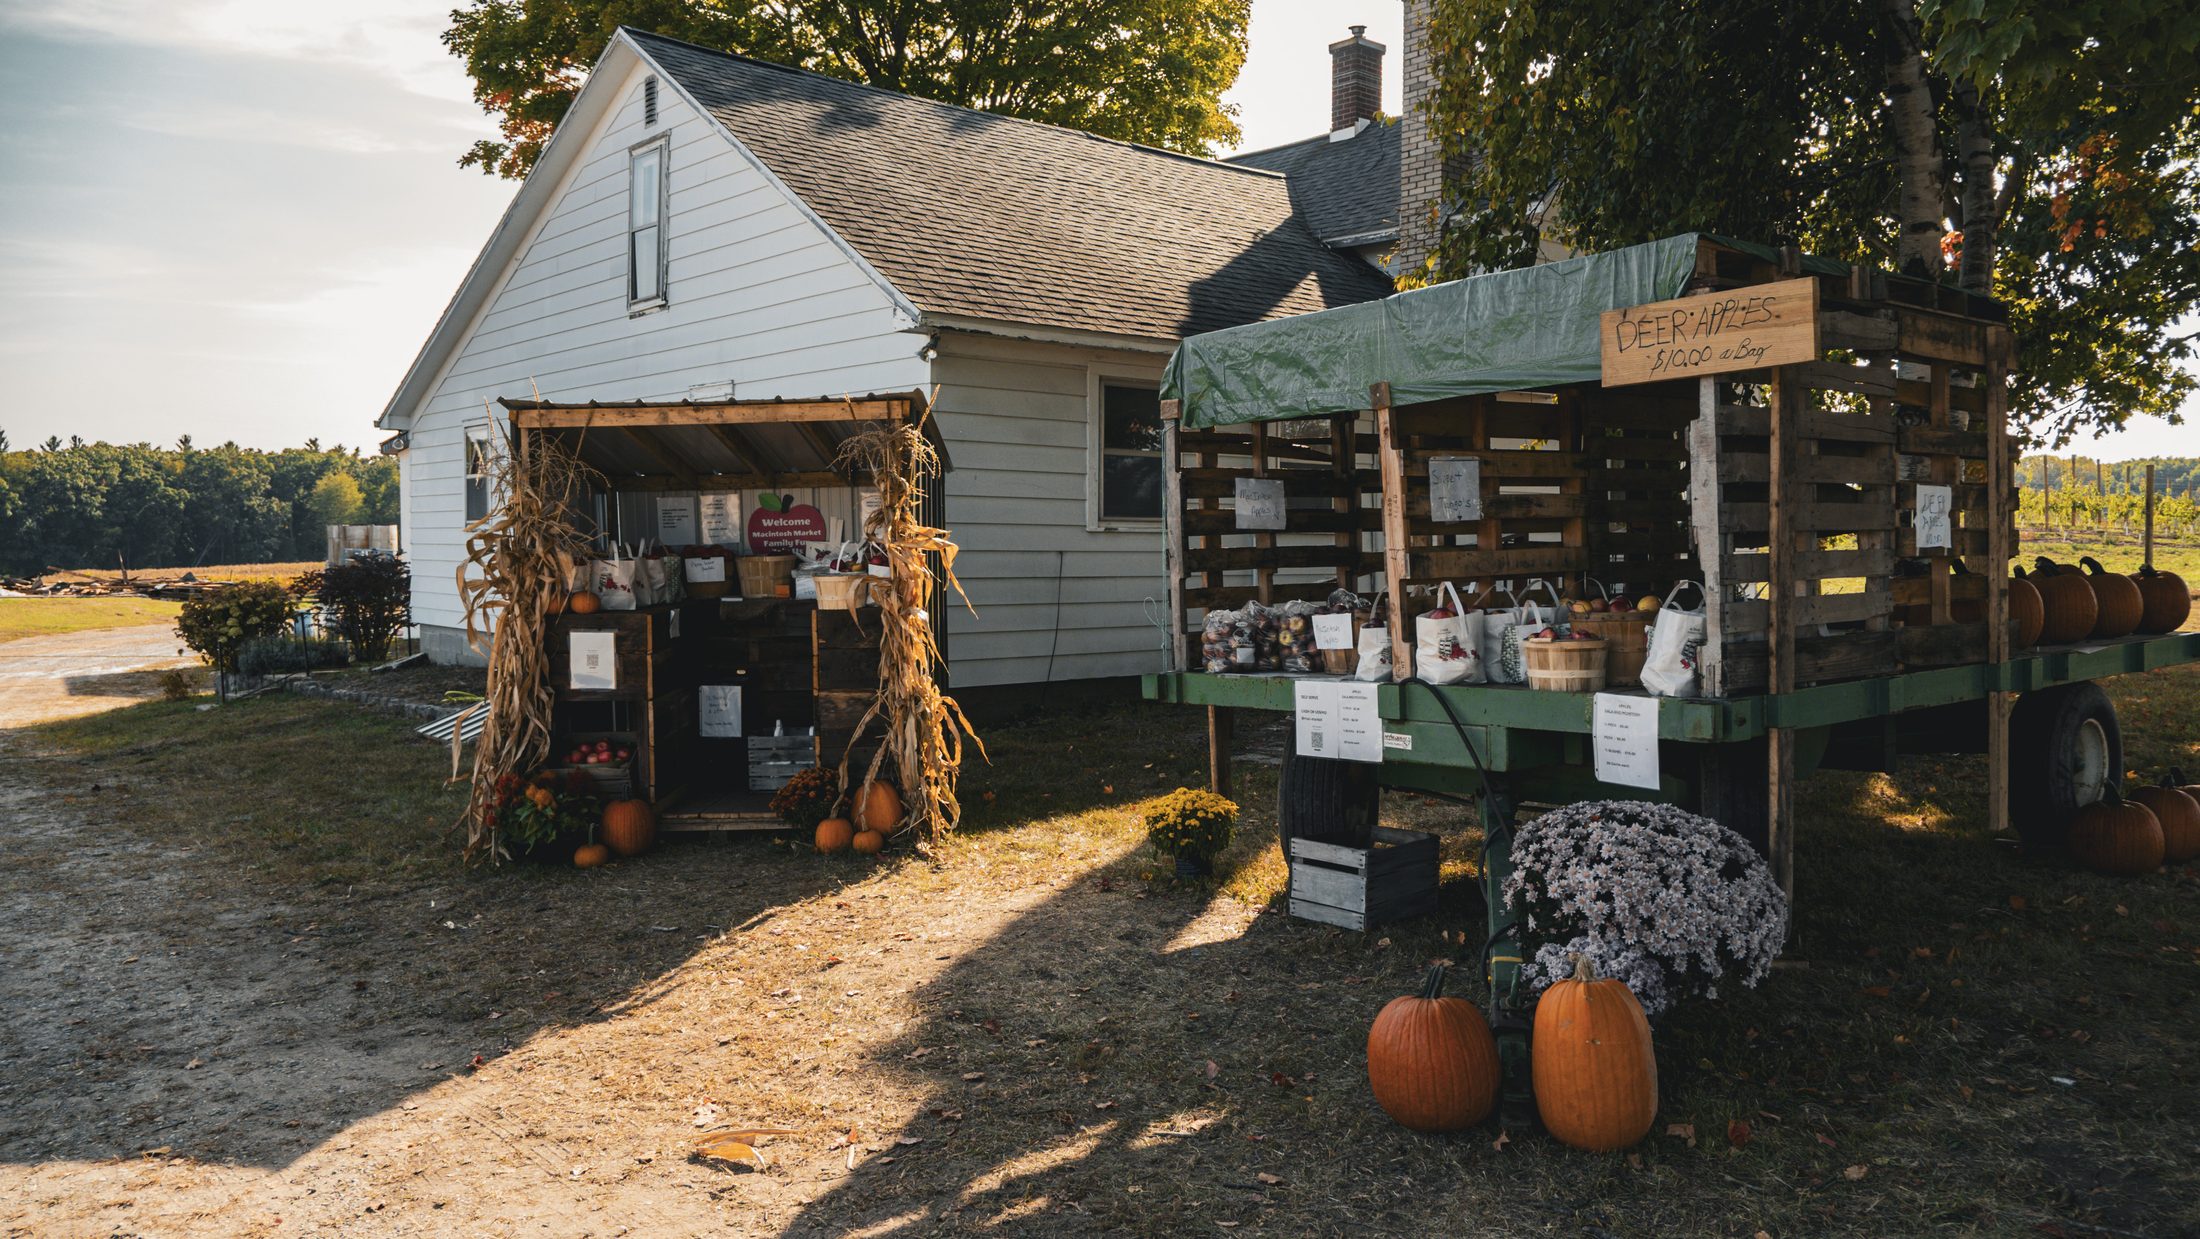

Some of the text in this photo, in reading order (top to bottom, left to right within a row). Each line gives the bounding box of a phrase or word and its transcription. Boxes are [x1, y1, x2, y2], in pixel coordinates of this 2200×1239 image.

[1615, 309, 1688, 353] DEER
[1732, 337, 1773, 365] Bag
[761, 517, 811, 527] Welcome
[752, 529, 821, 538] Macintosh Market
[763, 539, 794, 548] Family
